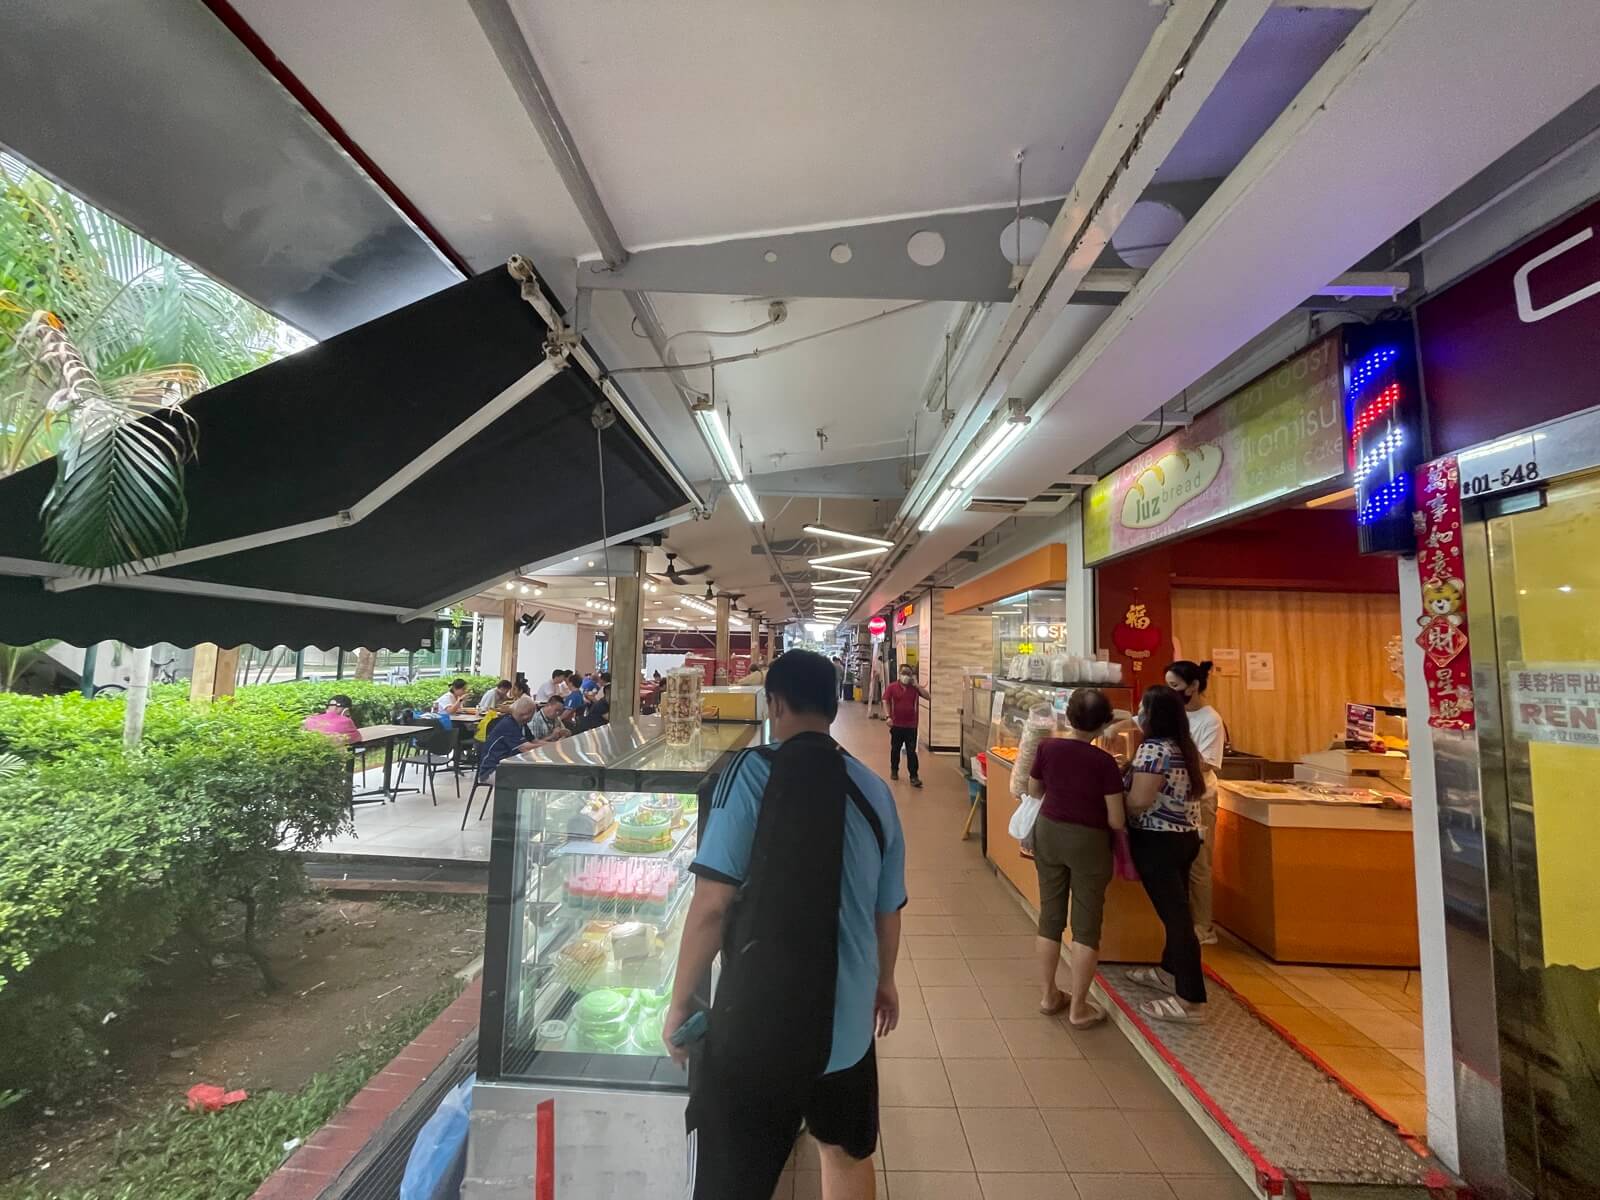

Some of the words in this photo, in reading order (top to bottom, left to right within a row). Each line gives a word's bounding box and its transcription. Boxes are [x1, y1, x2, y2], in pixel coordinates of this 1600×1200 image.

[1161, 471, 1201, 503] bread
[1463, 461, 1539, 495] #01-548
[1125, 604, 1151, 630] 福
[1519, 703, 1600, 730] REN
